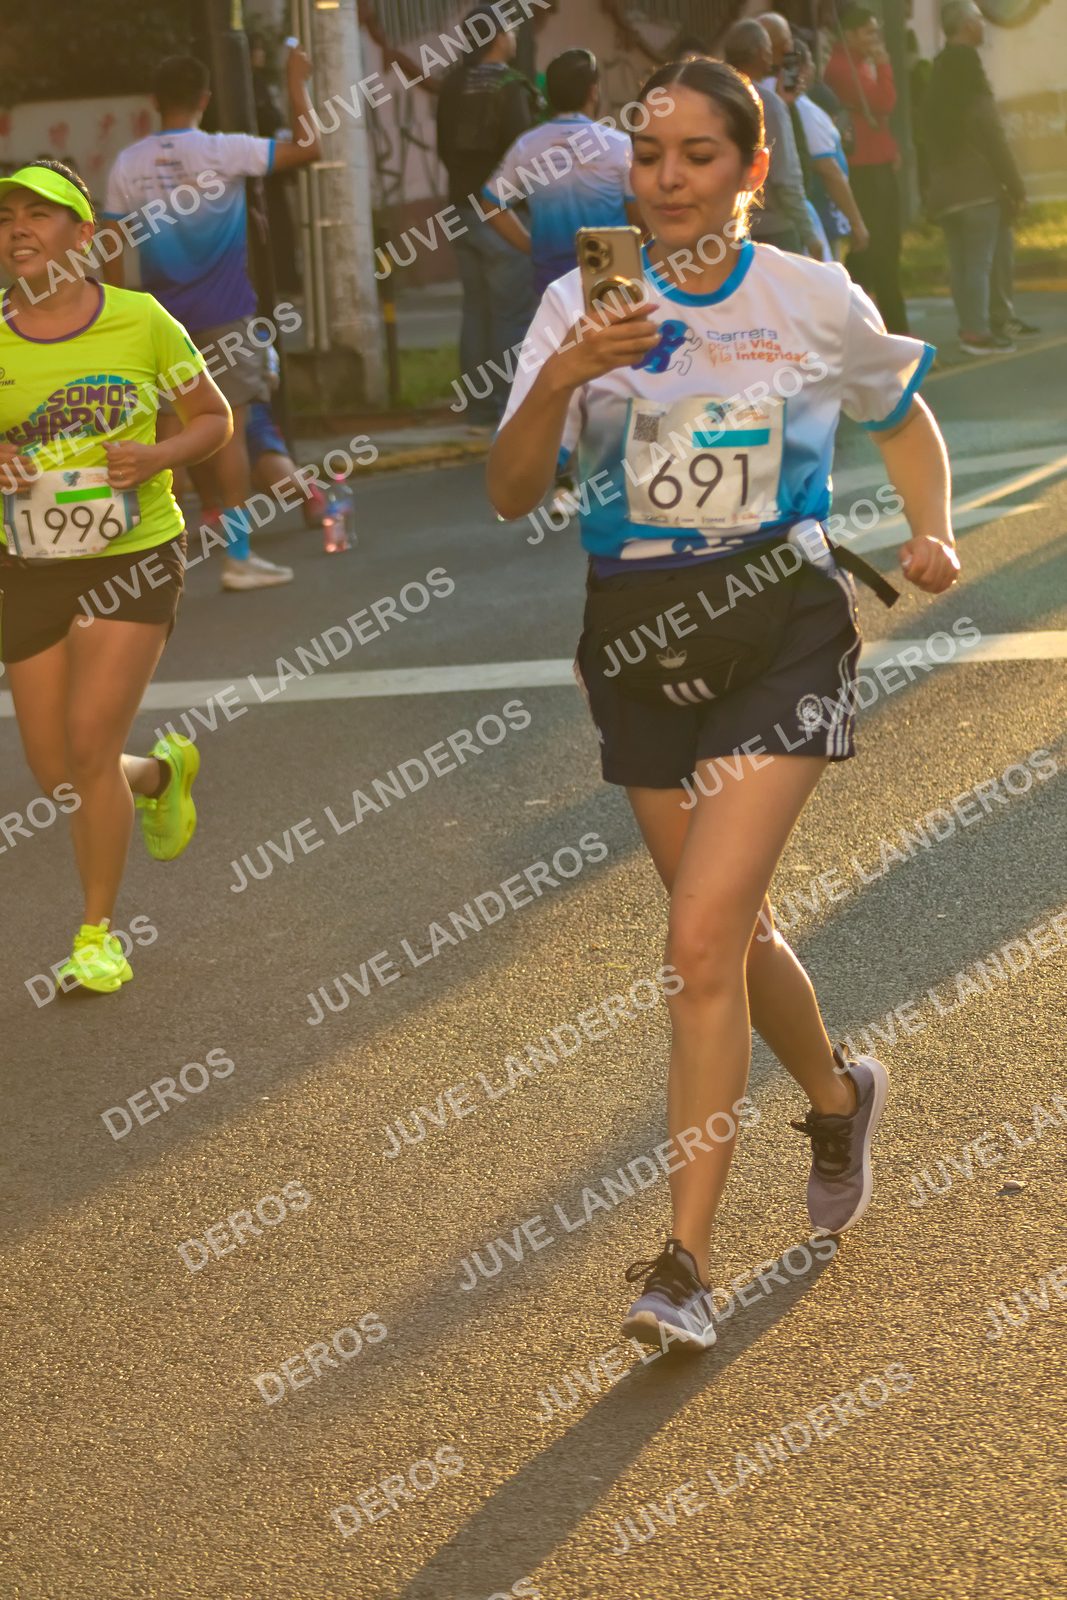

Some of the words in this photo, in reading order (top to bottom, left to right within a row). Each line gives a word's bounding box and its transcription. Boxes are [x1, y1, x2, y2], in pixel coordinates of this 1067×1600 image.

[706, 328, 778, 342] Carrera
[752, 339, 781, 351] Vida
[46, 385, 138, 413] SOMOS
[648, 454, 748, 509] 691
[21, 503, 123, 545] 1996
